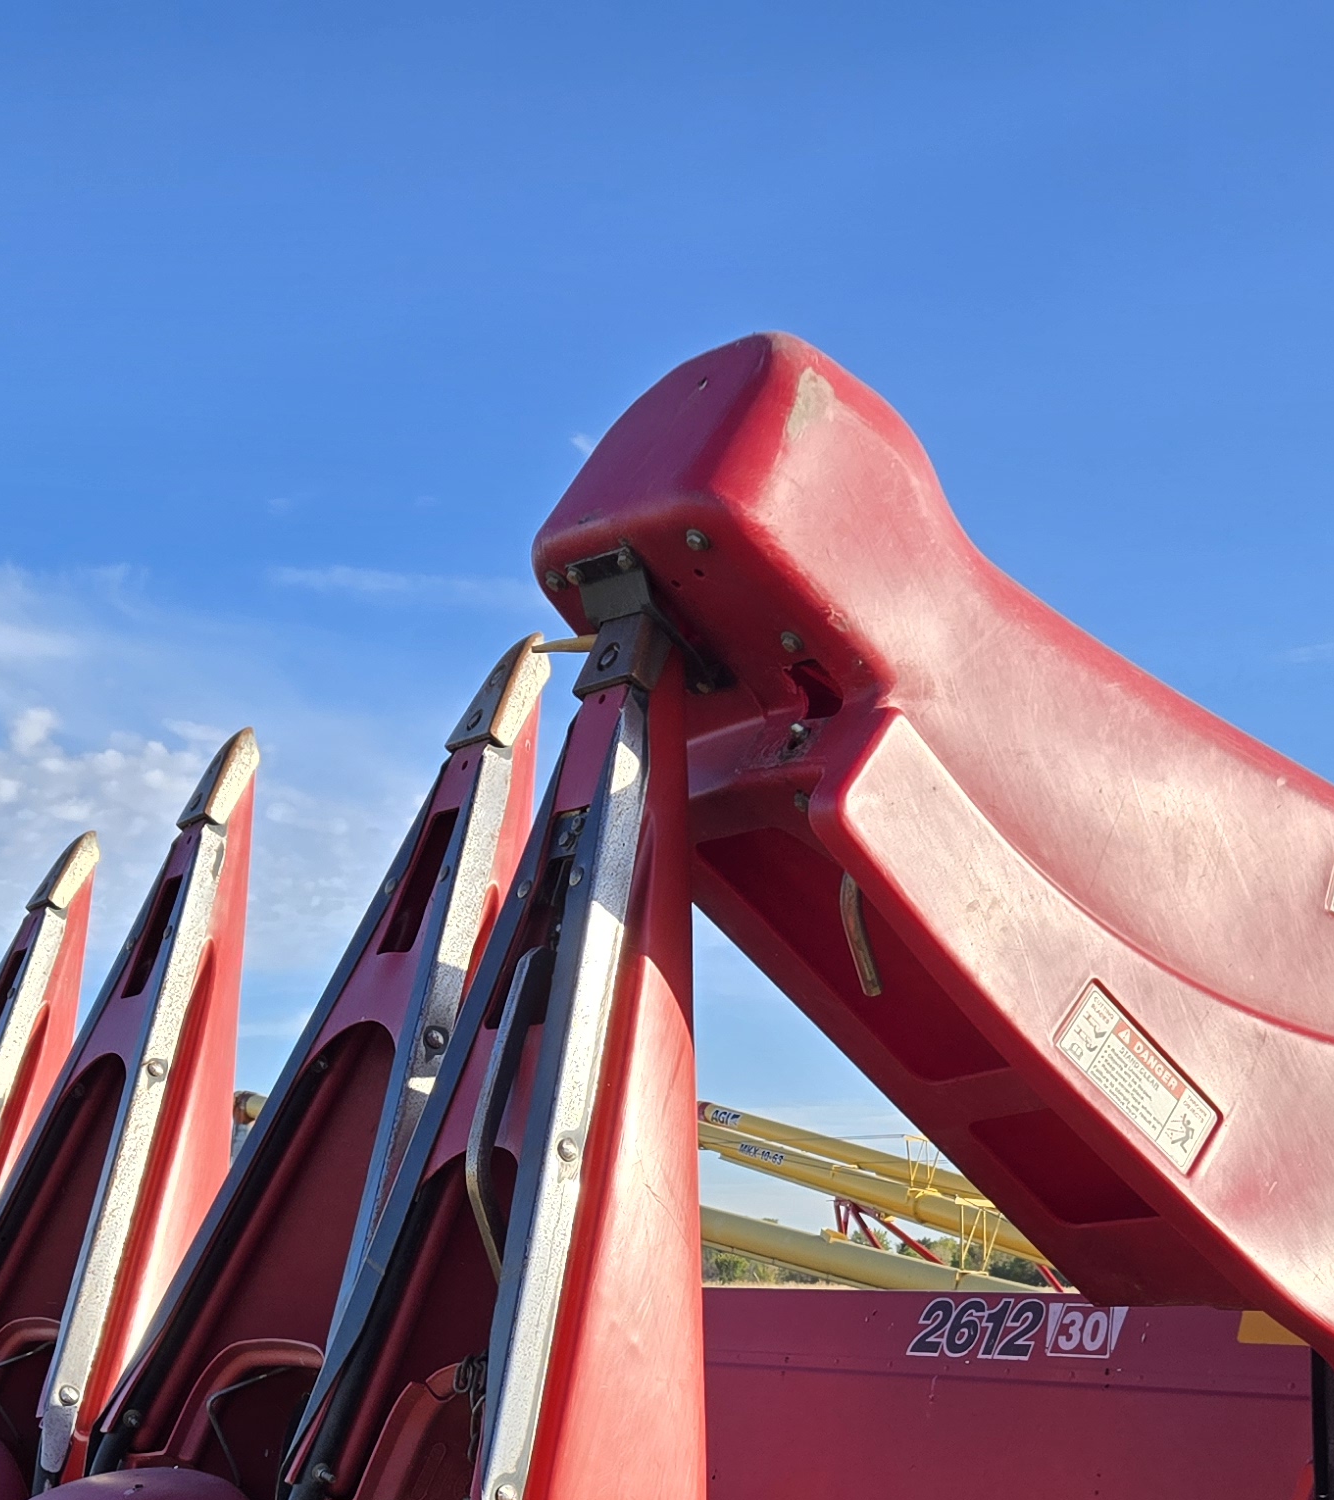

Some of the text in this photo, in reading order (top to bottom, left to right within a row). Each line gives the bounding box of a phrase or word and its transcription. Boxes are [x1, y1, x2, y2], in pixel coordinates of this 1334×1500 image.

[1092, 995, 1114, 1020] CUTTING
[1118, 1046, 1160, 1091] STAND CLEAR
[1132, 1040, 1178, 1091] DANGER
[711, 1110, 731, 1125] AGI
[739, 1143, 784, 1165] MKX-10-63
[906, 1297, 1108, 1360] 2612 30
